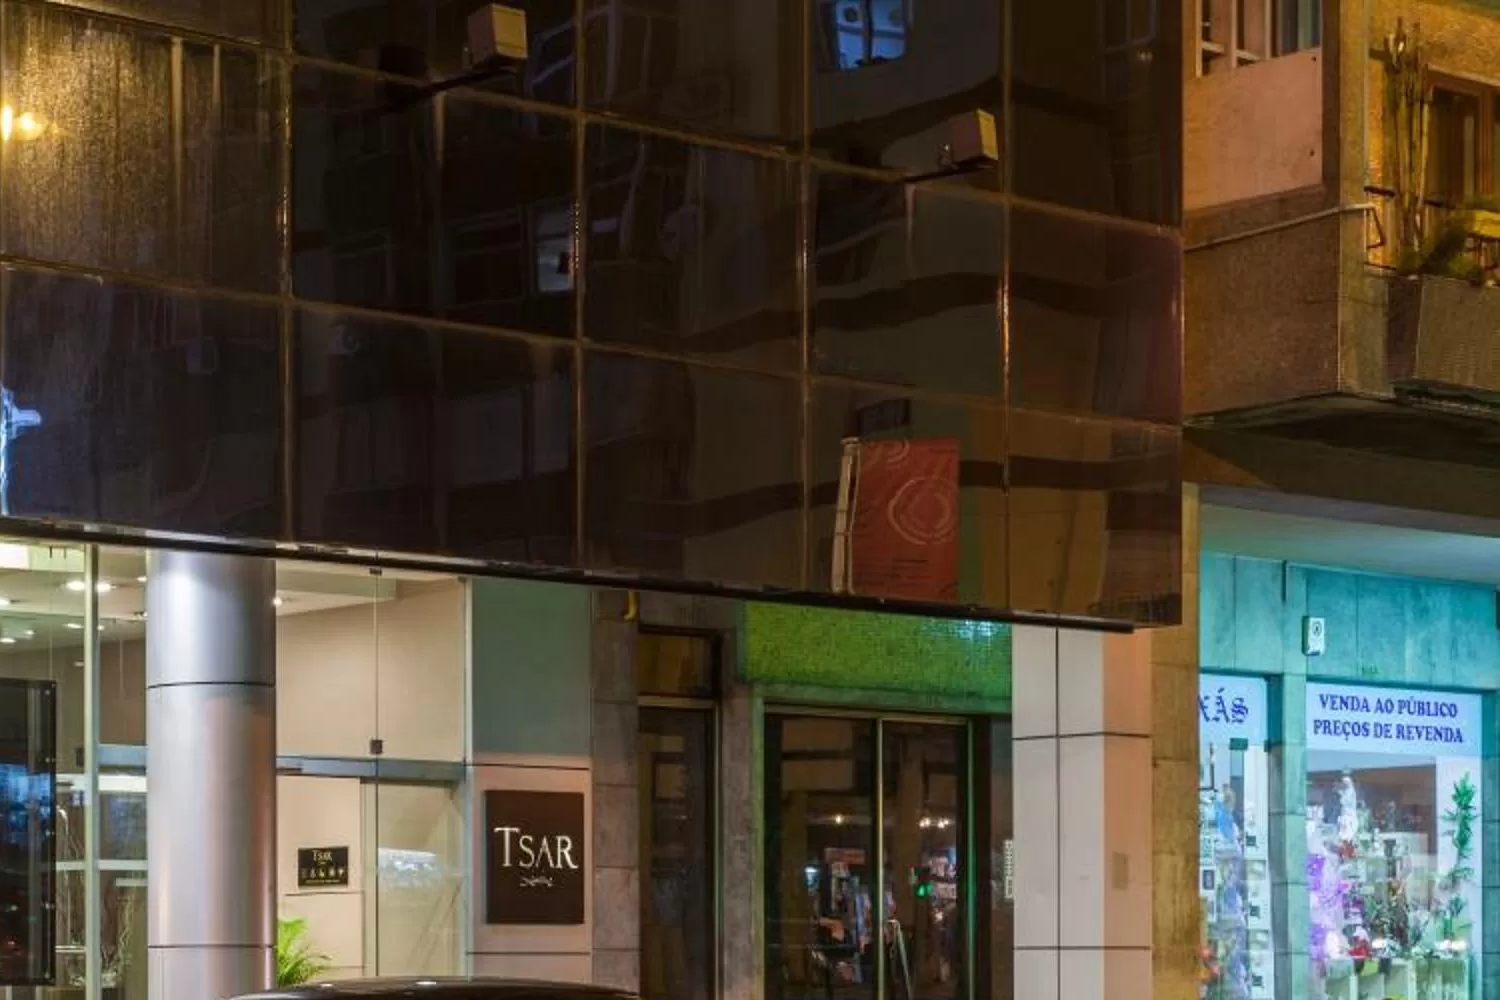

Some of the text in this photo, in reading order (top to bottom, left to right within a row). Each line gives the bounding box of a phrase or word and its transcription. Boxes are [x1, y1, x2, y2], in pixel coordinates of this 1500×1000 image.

[1319, 693, 1457, 718] VENDA AO PÚBLICO
[1313, 719, 1463, 743] PREÇOS DE REVENDA
[493, 826, 579, 869] TSAR
